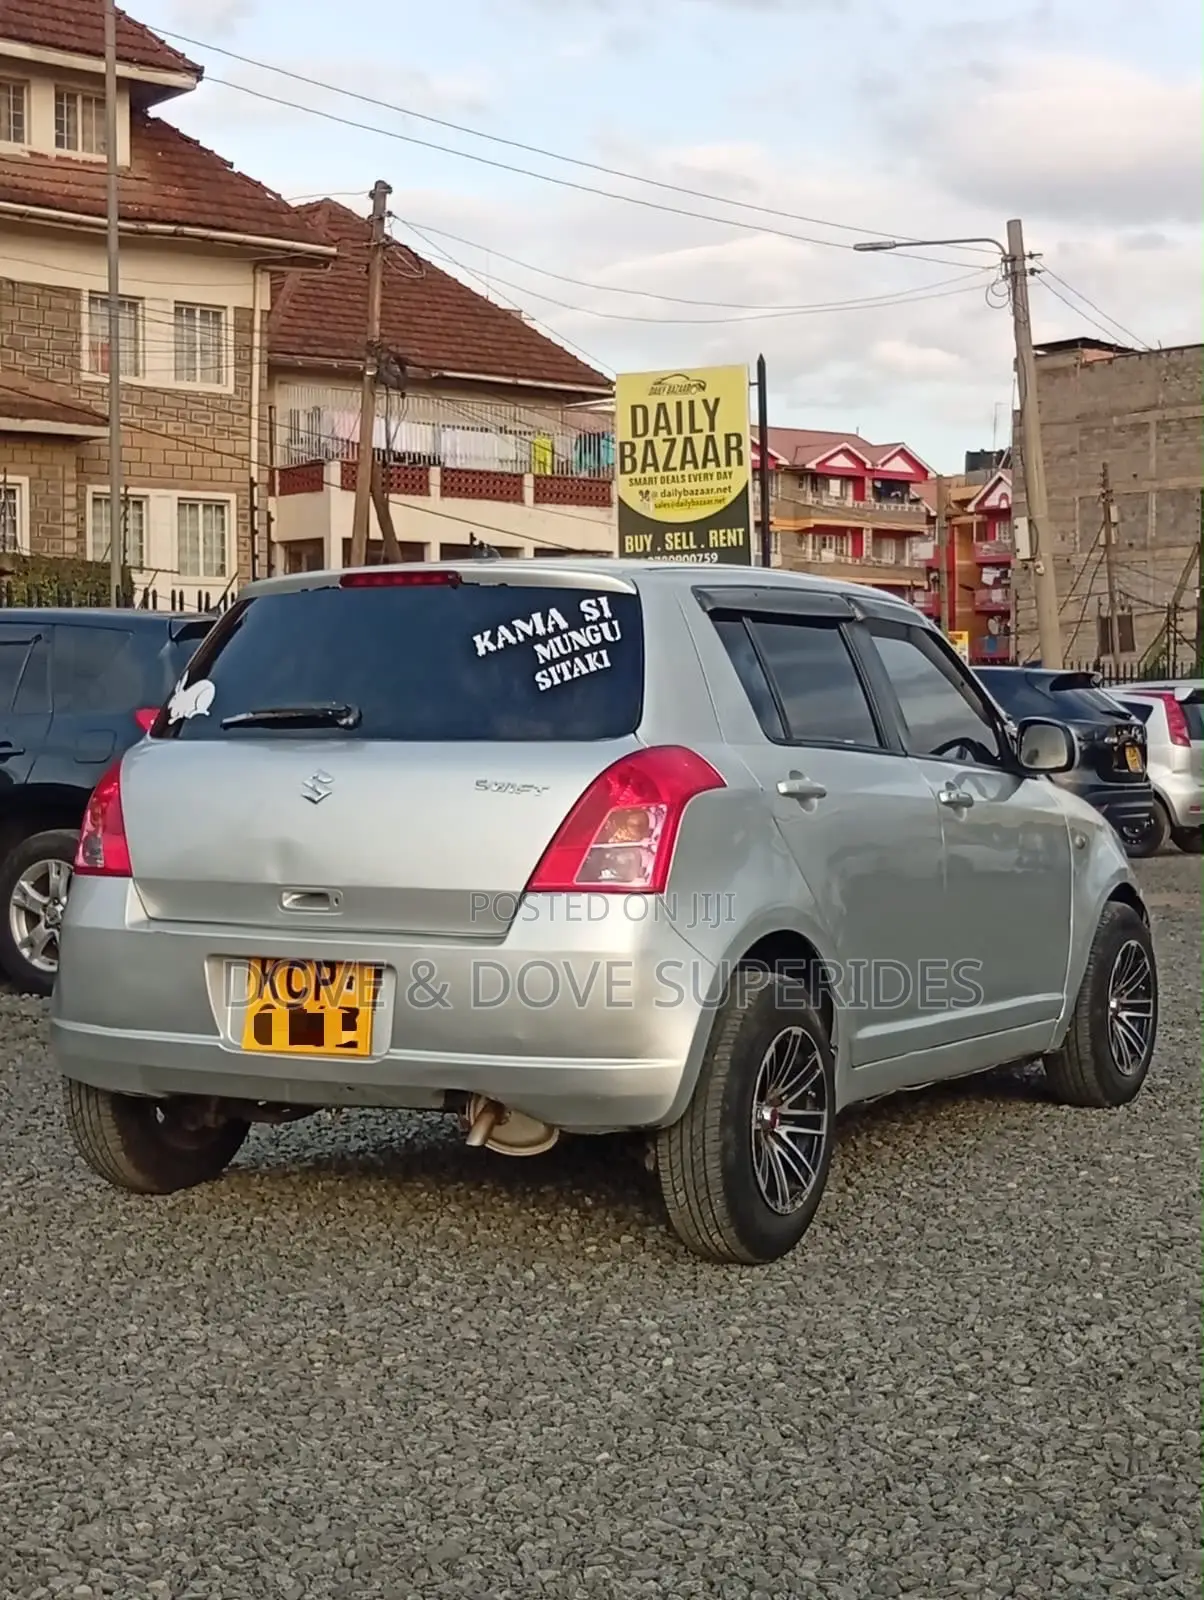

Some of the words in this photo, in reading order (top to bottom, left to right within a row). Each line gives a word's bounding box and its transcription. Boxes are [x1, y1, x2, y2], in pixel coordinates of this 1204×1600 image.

[630, 397, 721, 439] DAILY
[619, 432, 744, 475] BAZAAR
[629, 476, 657, 487] SMART
[660, 474, 686, 485] DEALS
[688, 472, 715, 483] EVERY
[717, 471, 733, 481] DAY
[660, 485, 732, 500] dailybazaar.net
[624, 534, 653, 553] BUY
[664, 531, 697, 551] SELL
[709, 528, 745, 548] RENT
[472, 607, 569, 657] KAMA
[579, 596, 613, 622] SI
[533, 620, 622, 664] MUNGU
[534, 649, 611, 691] SITAKI
